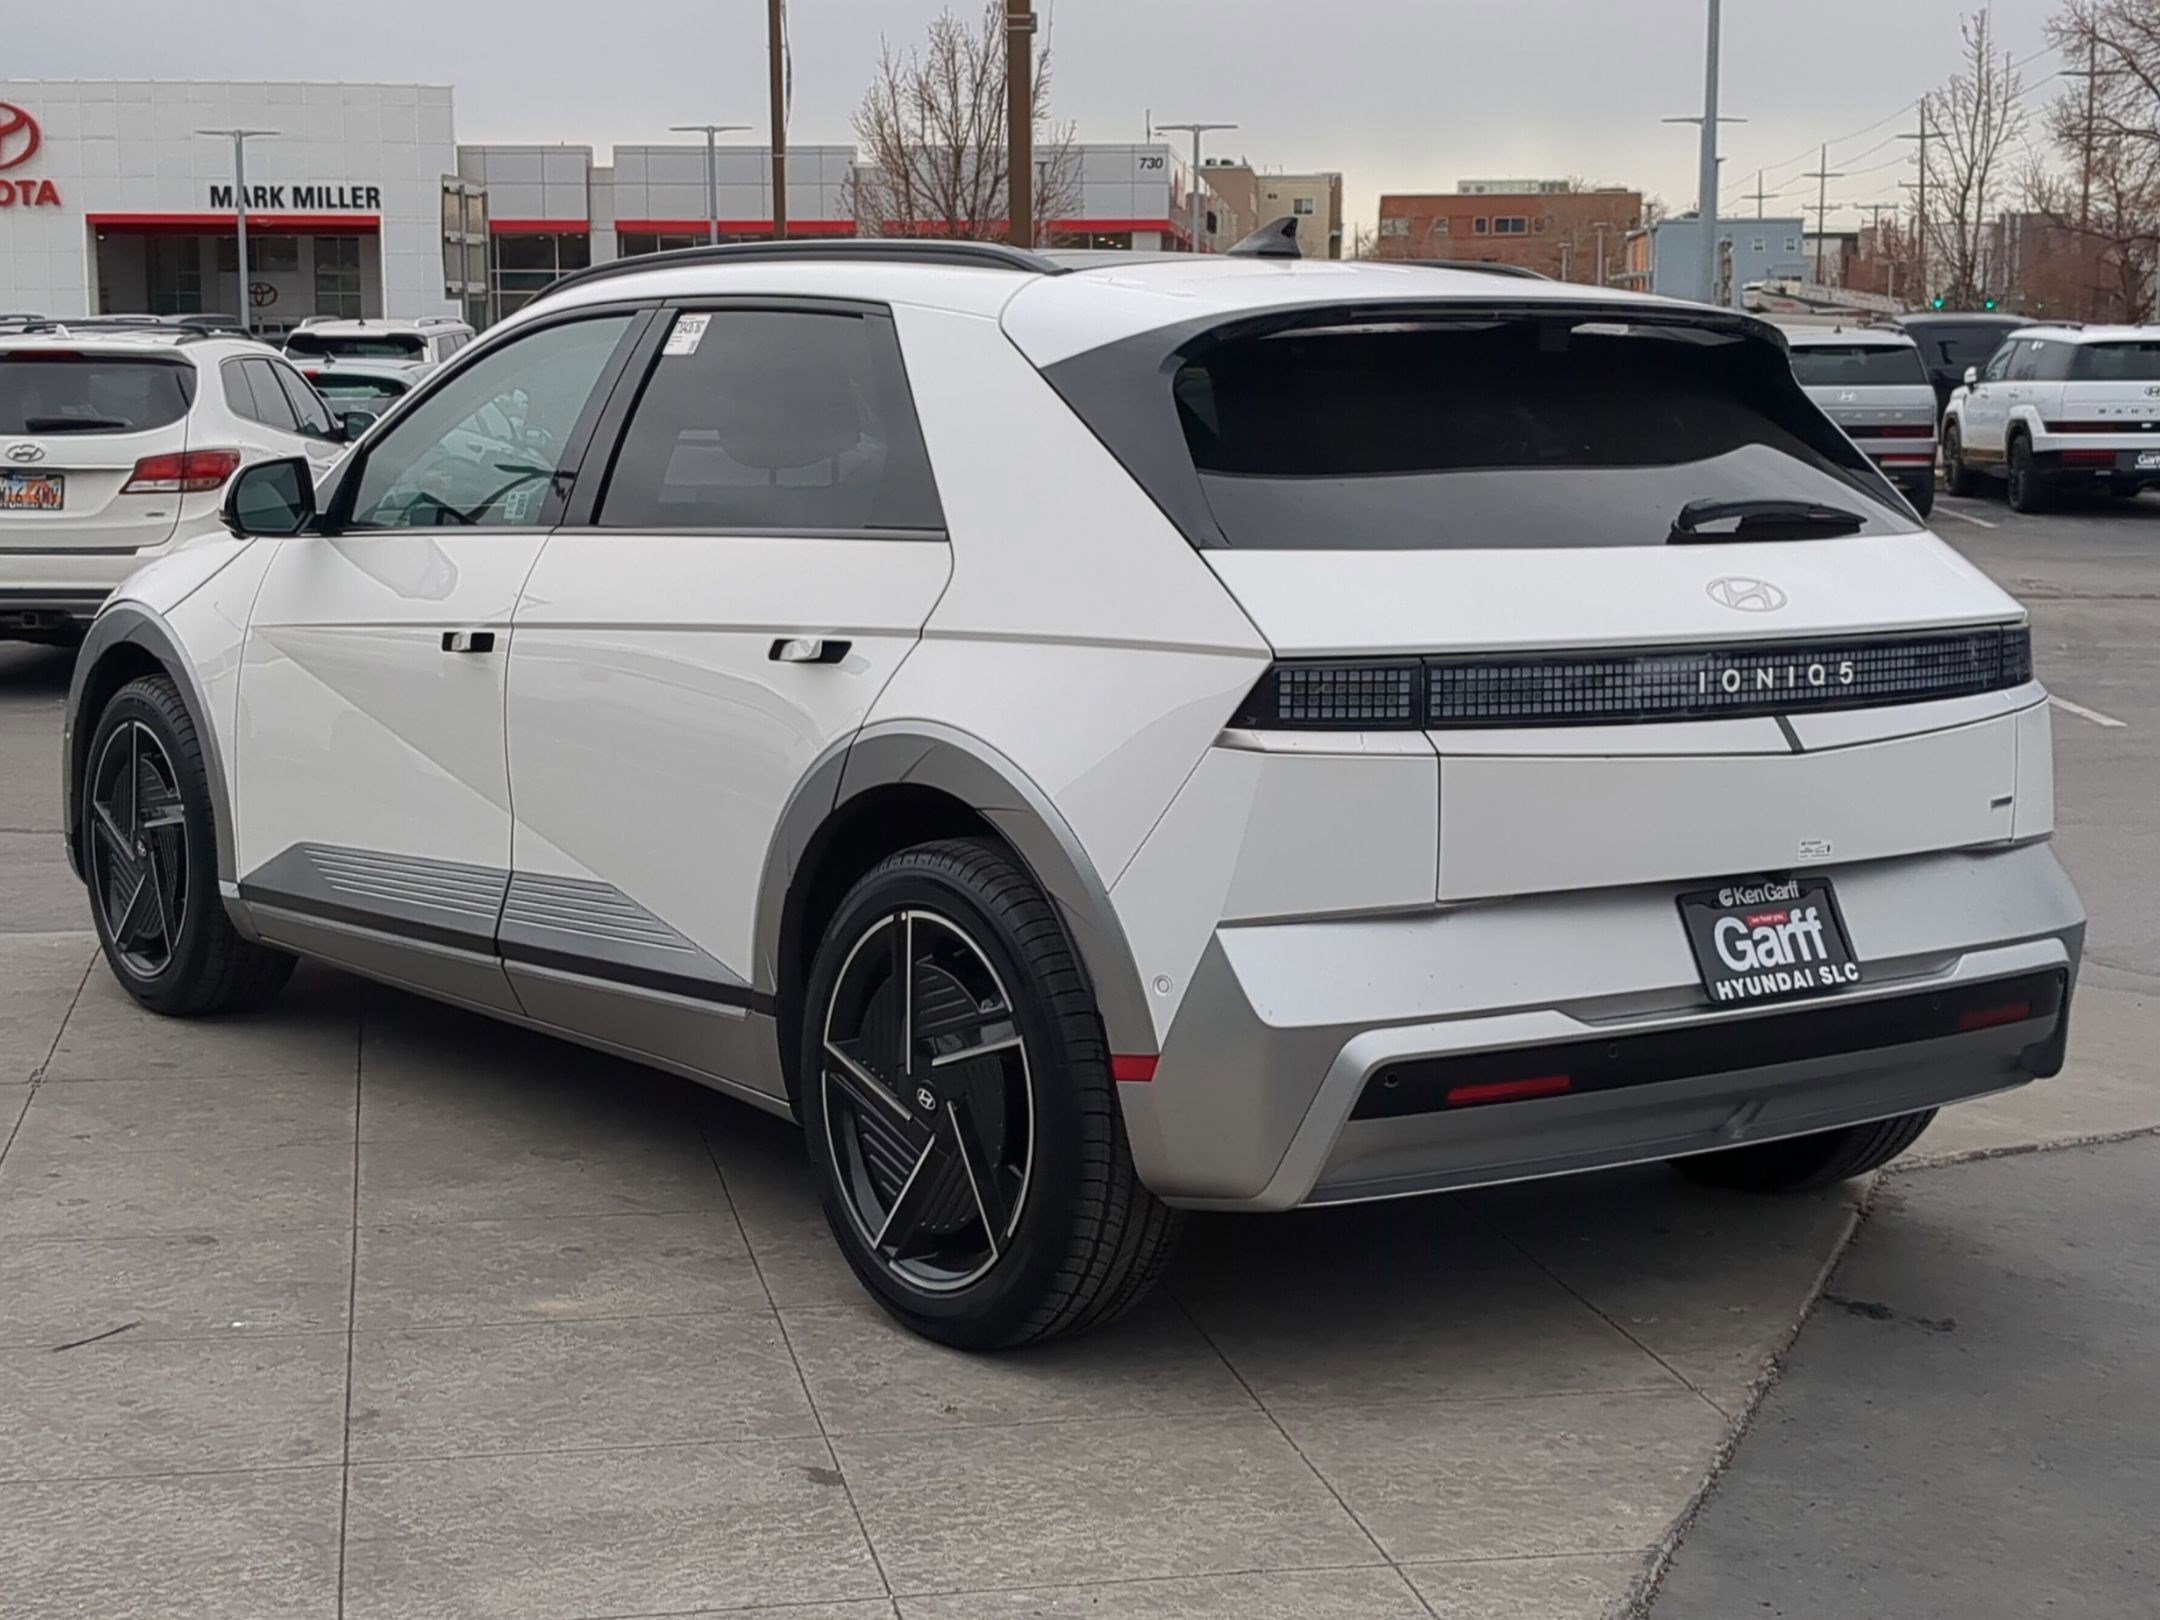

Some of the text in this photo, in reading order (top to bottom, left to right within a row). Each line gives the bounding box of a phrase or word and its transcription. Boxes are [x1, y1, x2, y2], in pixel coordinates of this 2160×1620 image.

[1140, 157, 1163, 169] 730
[210, 186, 381, 209] MARK MILLER
[1699, 661, 1854, 694] IONIQ 5
[1734, 881, 1800, 905] Ken Garff
[1714, 907, 1828, 972] Garff
[1716, 962, 1860, 1001] HYUNDAI SLC
